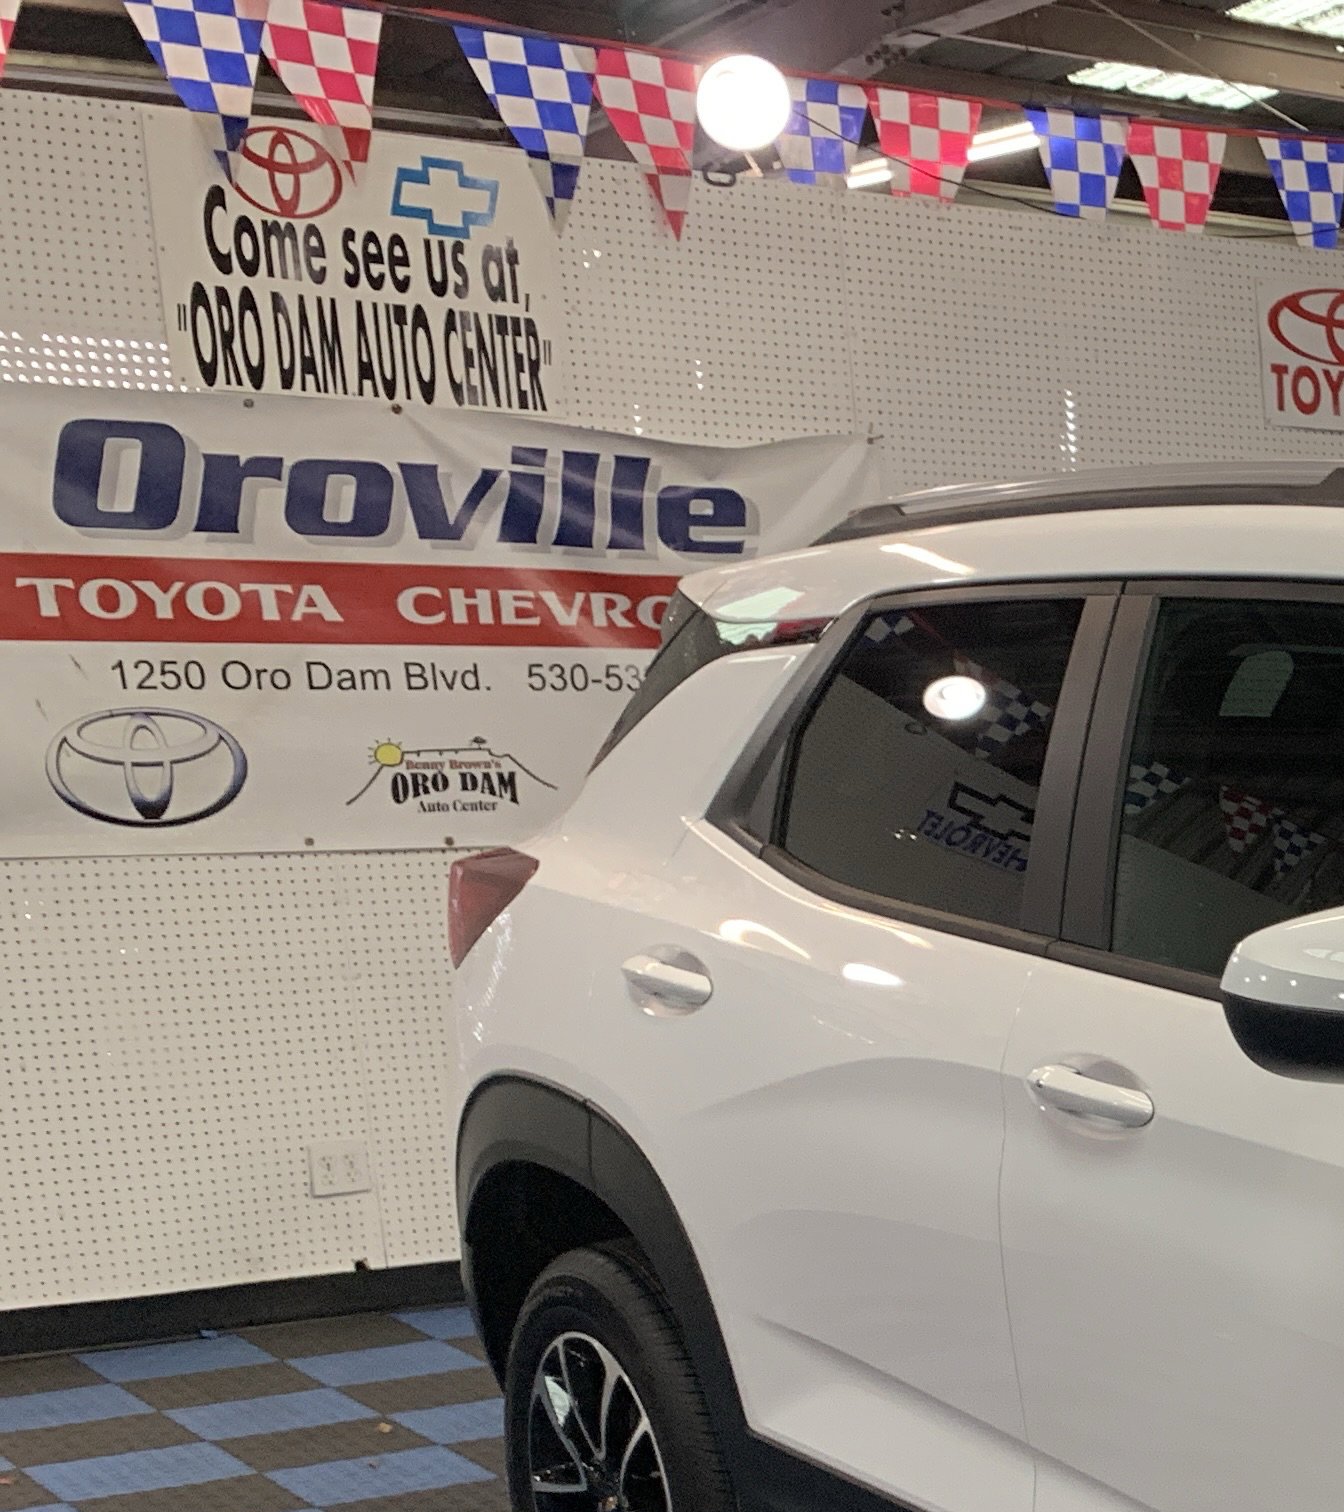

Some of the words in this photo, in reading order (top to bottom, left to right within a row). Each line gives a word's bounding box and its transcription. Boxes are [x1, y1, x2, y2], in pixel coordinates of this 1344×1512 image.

[204, 184, 327, 285] Come
[342, 227, 411, 293] see
[424, 238, 470, 300] us
[177, 281, 265, 391] "ORO
[270, 290, 347, 395] DAM
[356, 300, 436, 405] AUTO
[444, 308, 552, 412] CENTER"
[52, 418, 748, 556] Oroville
[15, 577, 345, 622] TOYOTA
[111, 659, 206, 690] 1250
[221, 660, 291, 690] Oro
[306, 661, 391, 690] Dam
[405, 661, 492, 691] Blvd.
[527, 663, 650, 693] 530-53
[405, 758, 446, 770] Benny
[391, 771, 449, 804] ORO
[458, 771, 520, 806] DAM
[417, 801, 449, 813] Auto
[453, 800, 498, 812] Center
